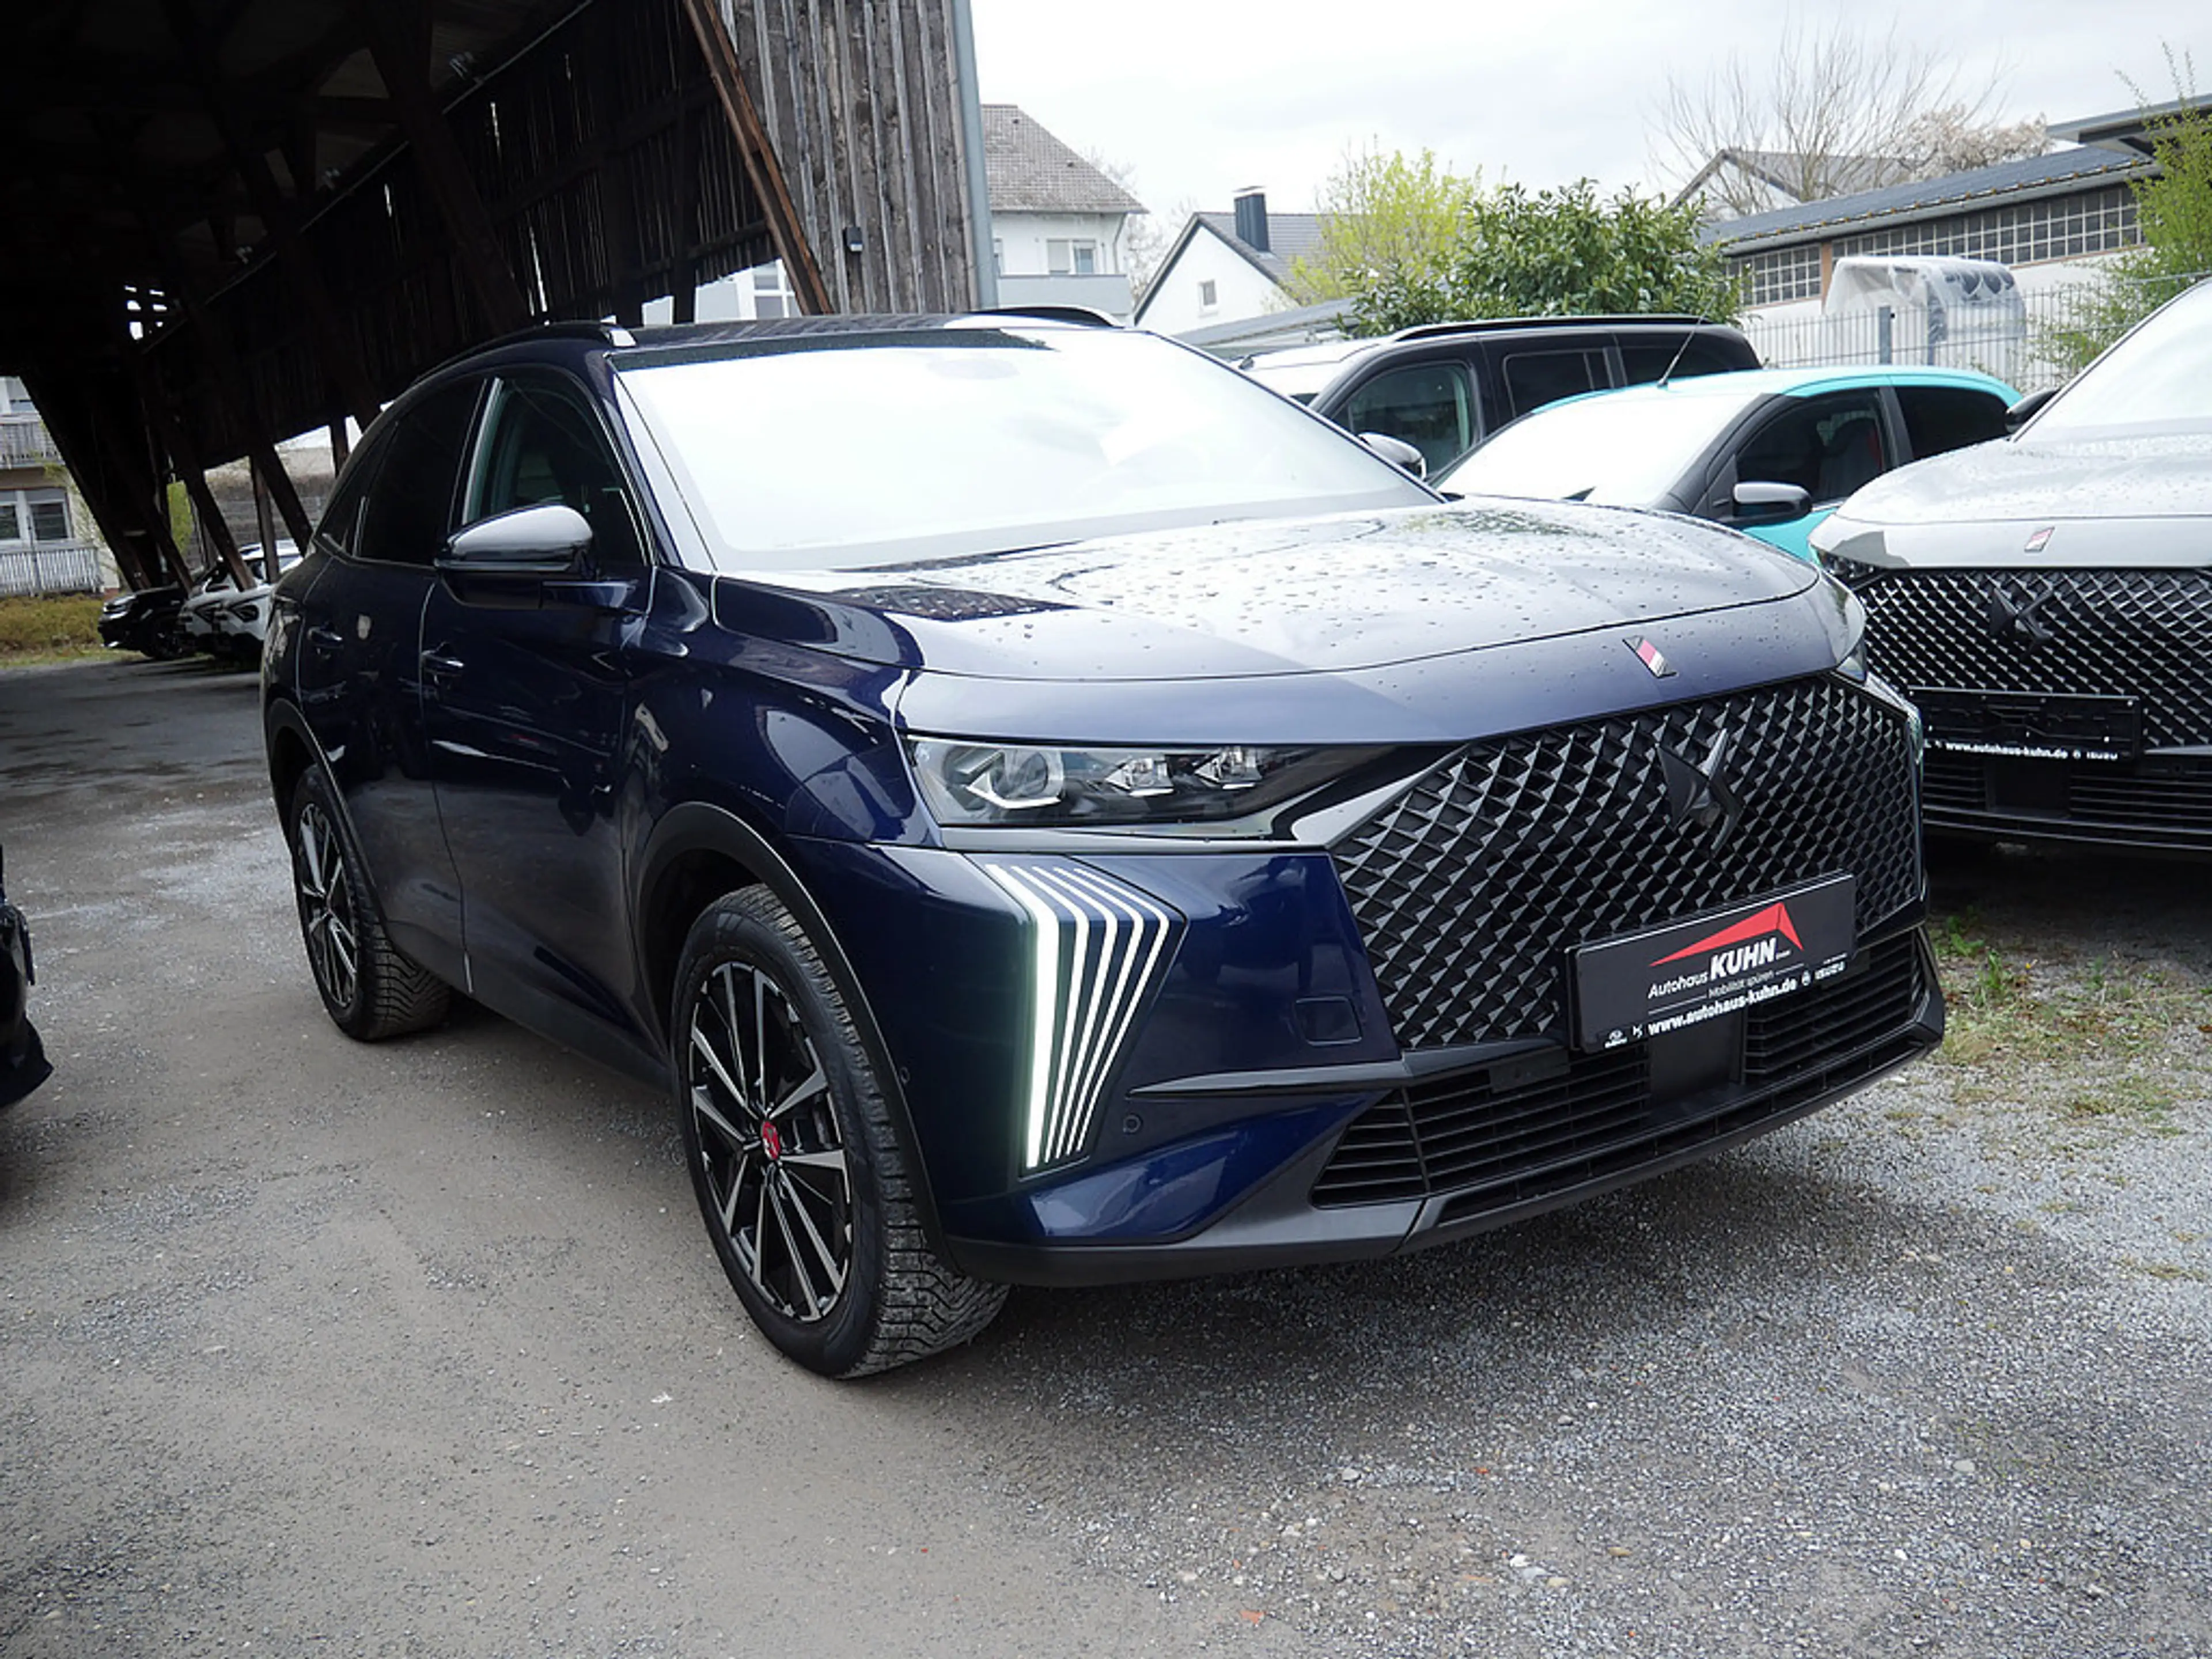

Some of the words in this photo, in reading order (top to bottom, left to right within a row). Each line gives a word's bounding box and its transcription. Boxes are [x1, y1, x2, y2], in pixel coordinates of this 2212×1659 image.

[1648, 971, 1709, 999] Autohaus
[1711, 937, 1777, 980] KUHN
[1648, 978, 1797, 1036] www.autohaus-kuhn.de
